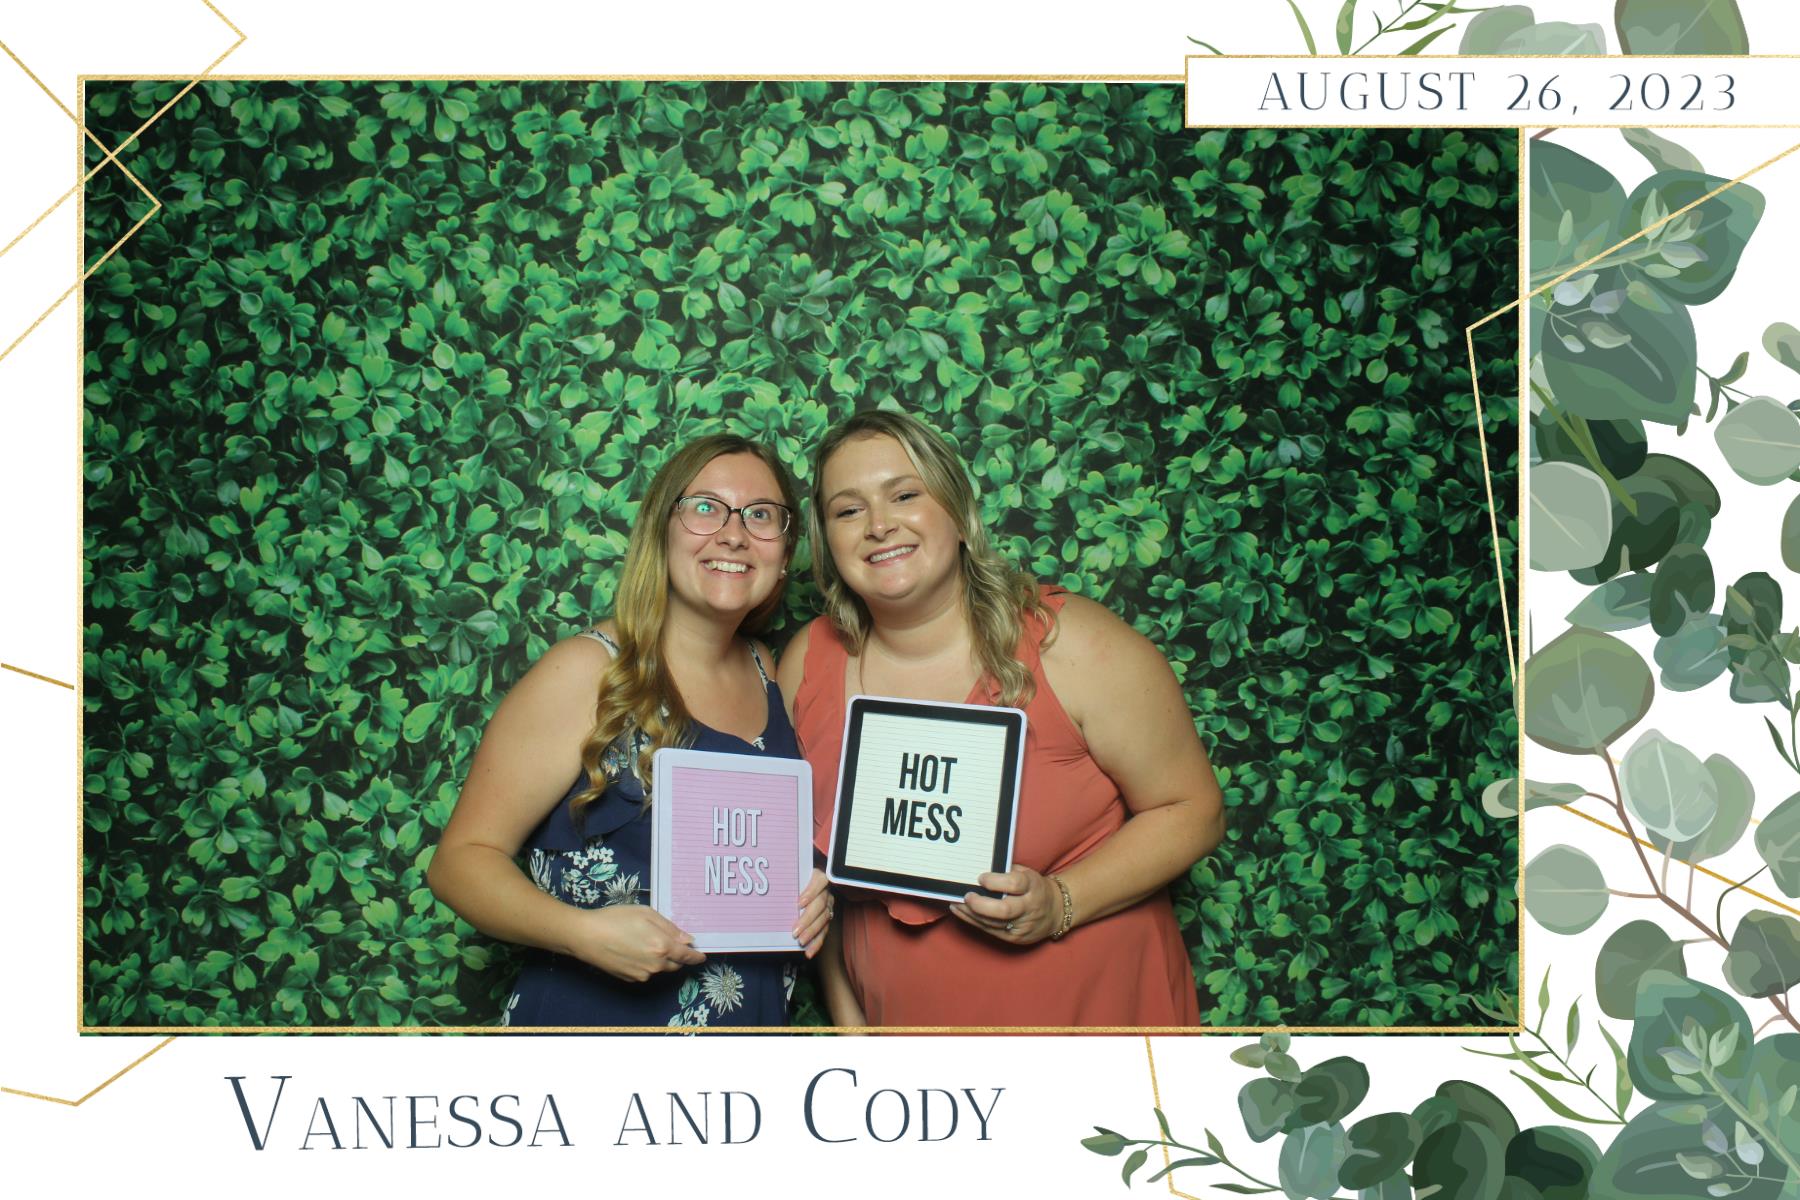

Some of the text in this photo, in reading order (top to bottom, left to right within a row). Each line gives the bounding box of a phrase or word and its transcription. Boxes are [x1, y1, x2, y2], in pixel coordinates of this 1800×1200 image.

[899, 752, 958, 794] HOT
[711, 806, 763, 848] HOT
[882, 798, 963, 844] MESS
[703, 855, 770, 896] NESS
